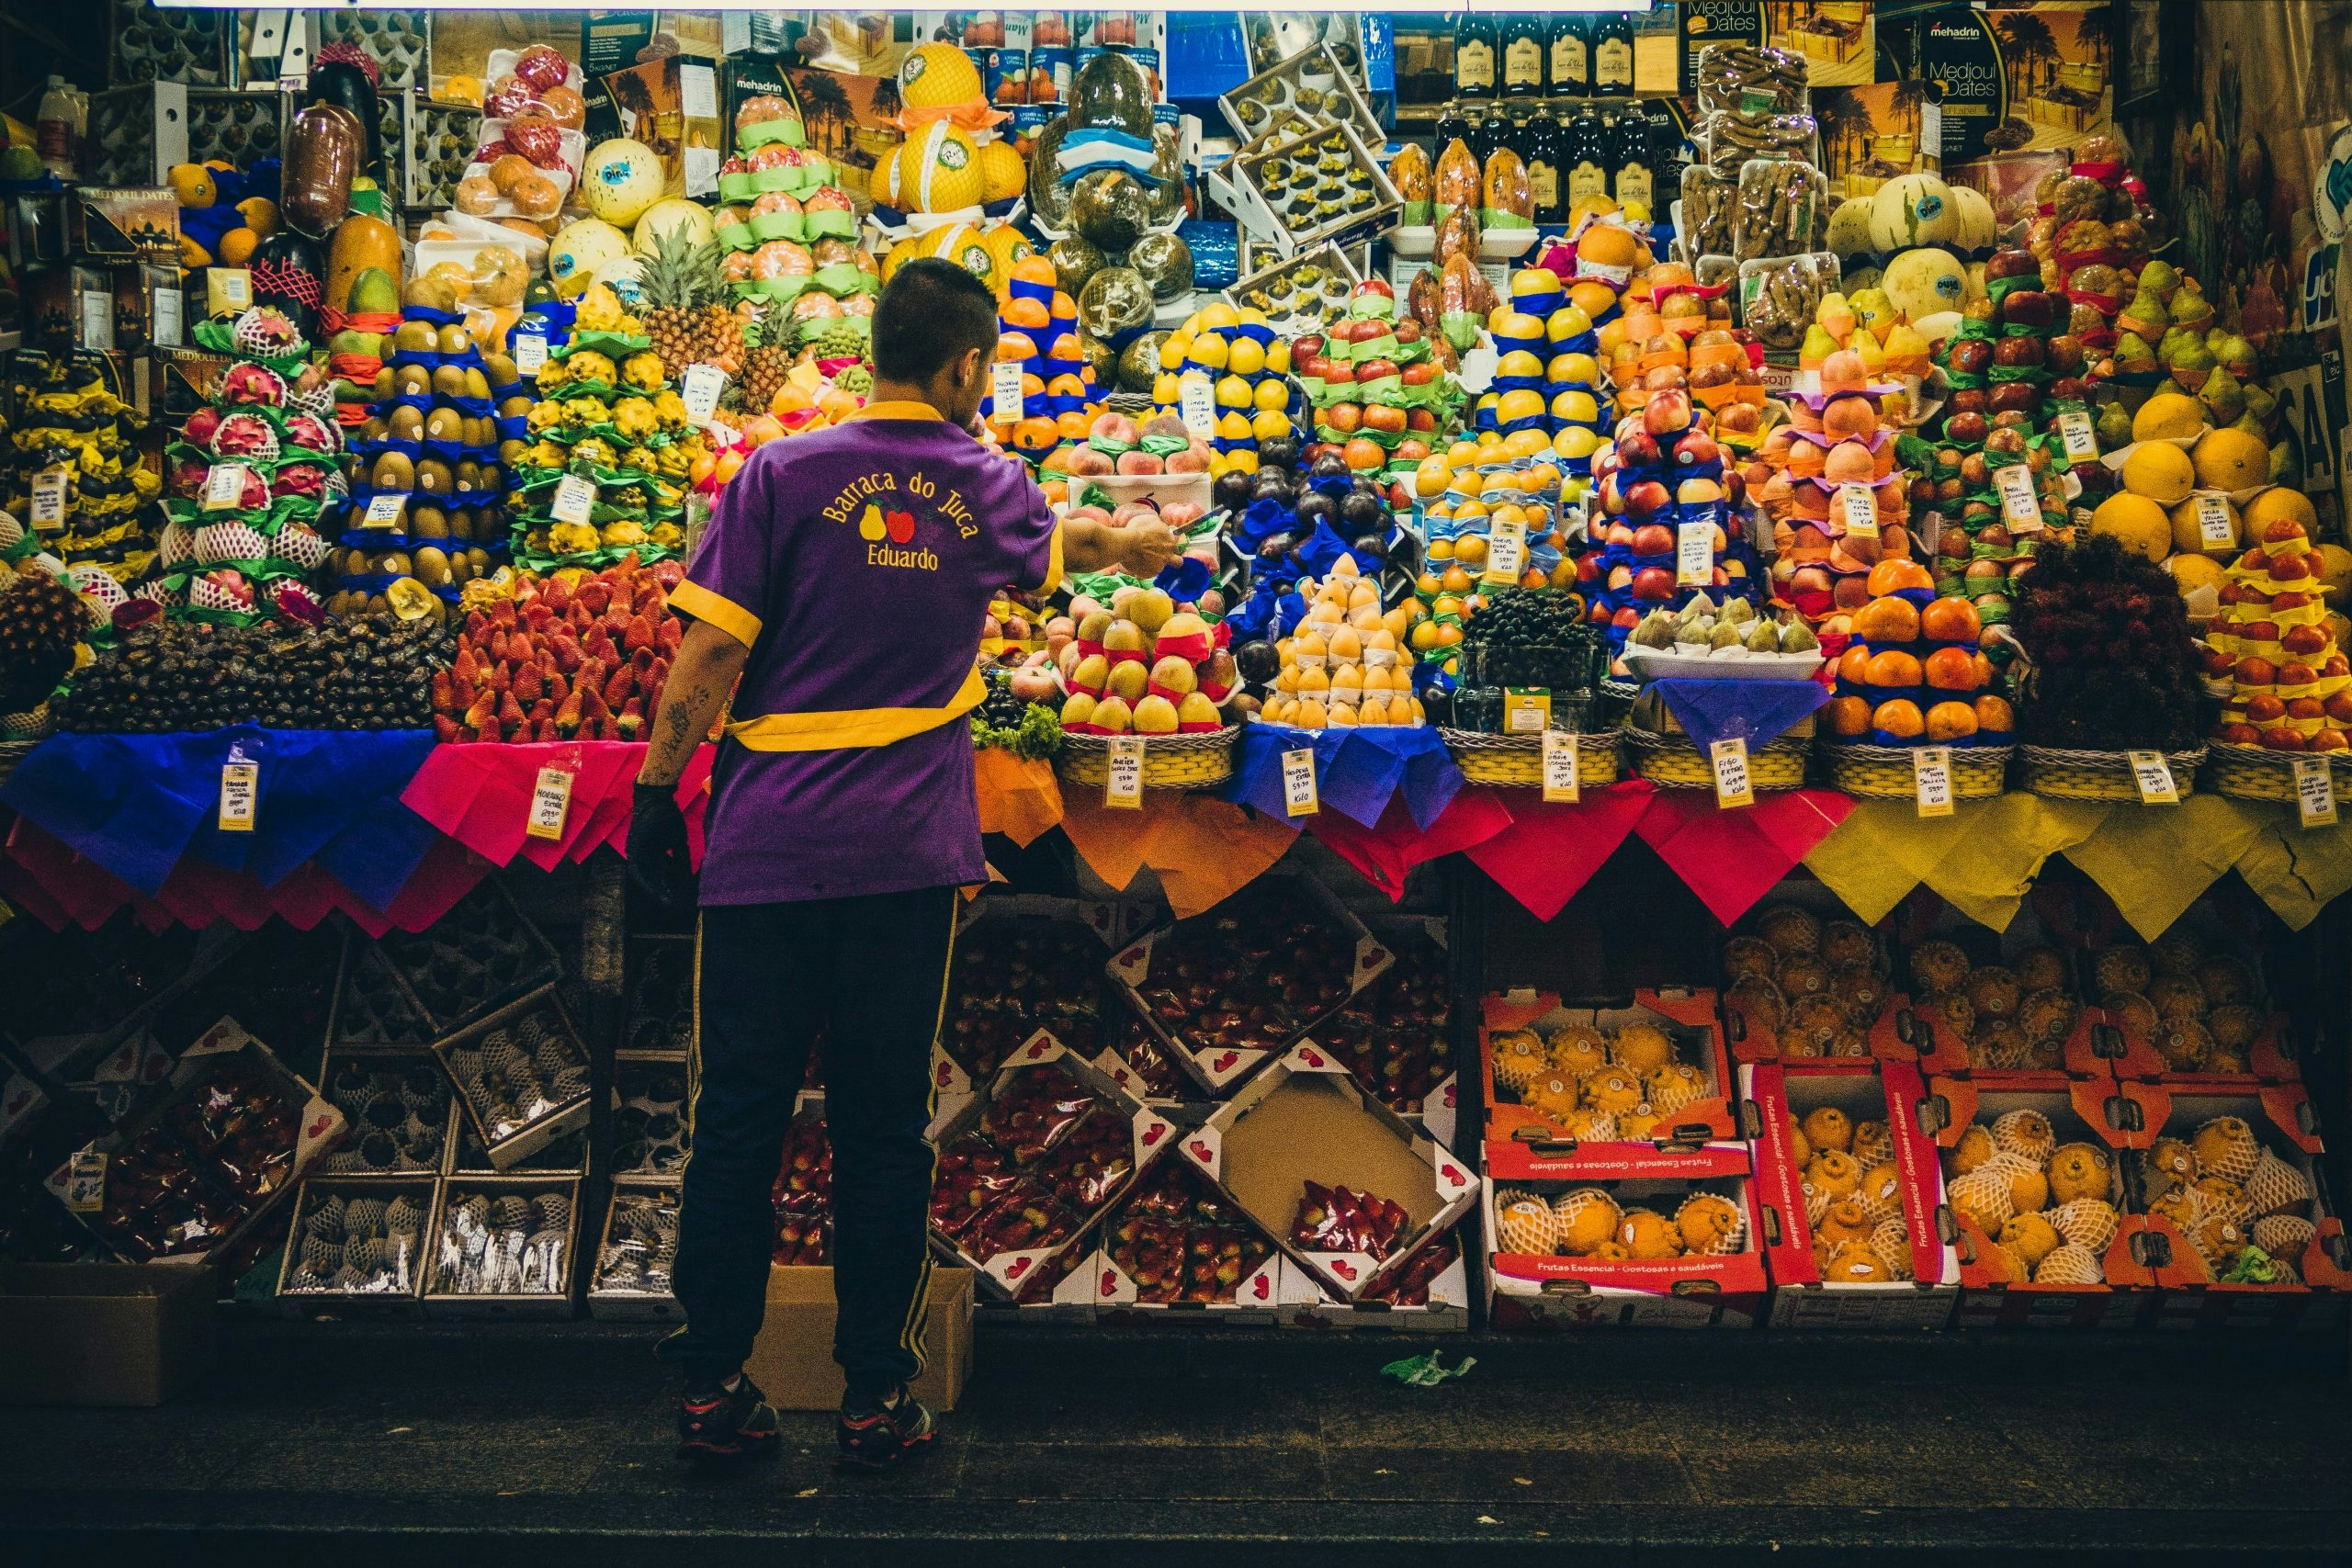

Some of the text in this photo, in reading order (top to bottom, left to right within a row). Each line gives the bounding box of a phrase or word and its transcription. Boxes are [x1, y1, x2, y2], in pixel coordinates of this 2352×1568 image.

[1688, 0, 1756, 17] Medjoul
[1706, 14, 1756, 32] Dates
[1930, 26, 1980, 38] mehadrin
[1929, 62, 1996, 84] Medjoul
[737, 79, 782, 93] mehadrin
[1944, 79, 1996, 97] Dates
[141, 190, 175, 201] DATES
[1920, 201, 1941, 218] Dino
[554, 261, 573, 274] Dino
[172, 350, 217, 363] MEDJOUL
[822, 471, 978, 539] Barraca do Juca
[867, 544, 938, 571] Eduardo
[1766, 1096, 1777, 1122] Frutas
[1894, 1092, 1907, 1132] saudáveis
[1771, 1122, 1785, 1159] Essencial
[1529, 1161, 1575, 1171] saudáveis
[1583, 1161, 1629, 1170] Gostosas
[1635, 1159, 1679, 1169] Essencial
[1680, 1158, 1713, 1168] Frutas
[1904, 1137, 1916, 1177] Gostosas
[1778, 1165, 1792, 1203] Gostosas
[1909, 1182, 1924, 1219] Essencial
[1787, 1210, 1801, 1249] saudáveis
[1917, 1221, 1928, 1247] Frutas
[1537, 1263, 1569, 1272] Frutas
[1571, 1264, 1615, 1273] Essencial
[1623, 1264, 1669, 1274] Gostosas
[1678, 1261, 1724, 1273] saudáveis
